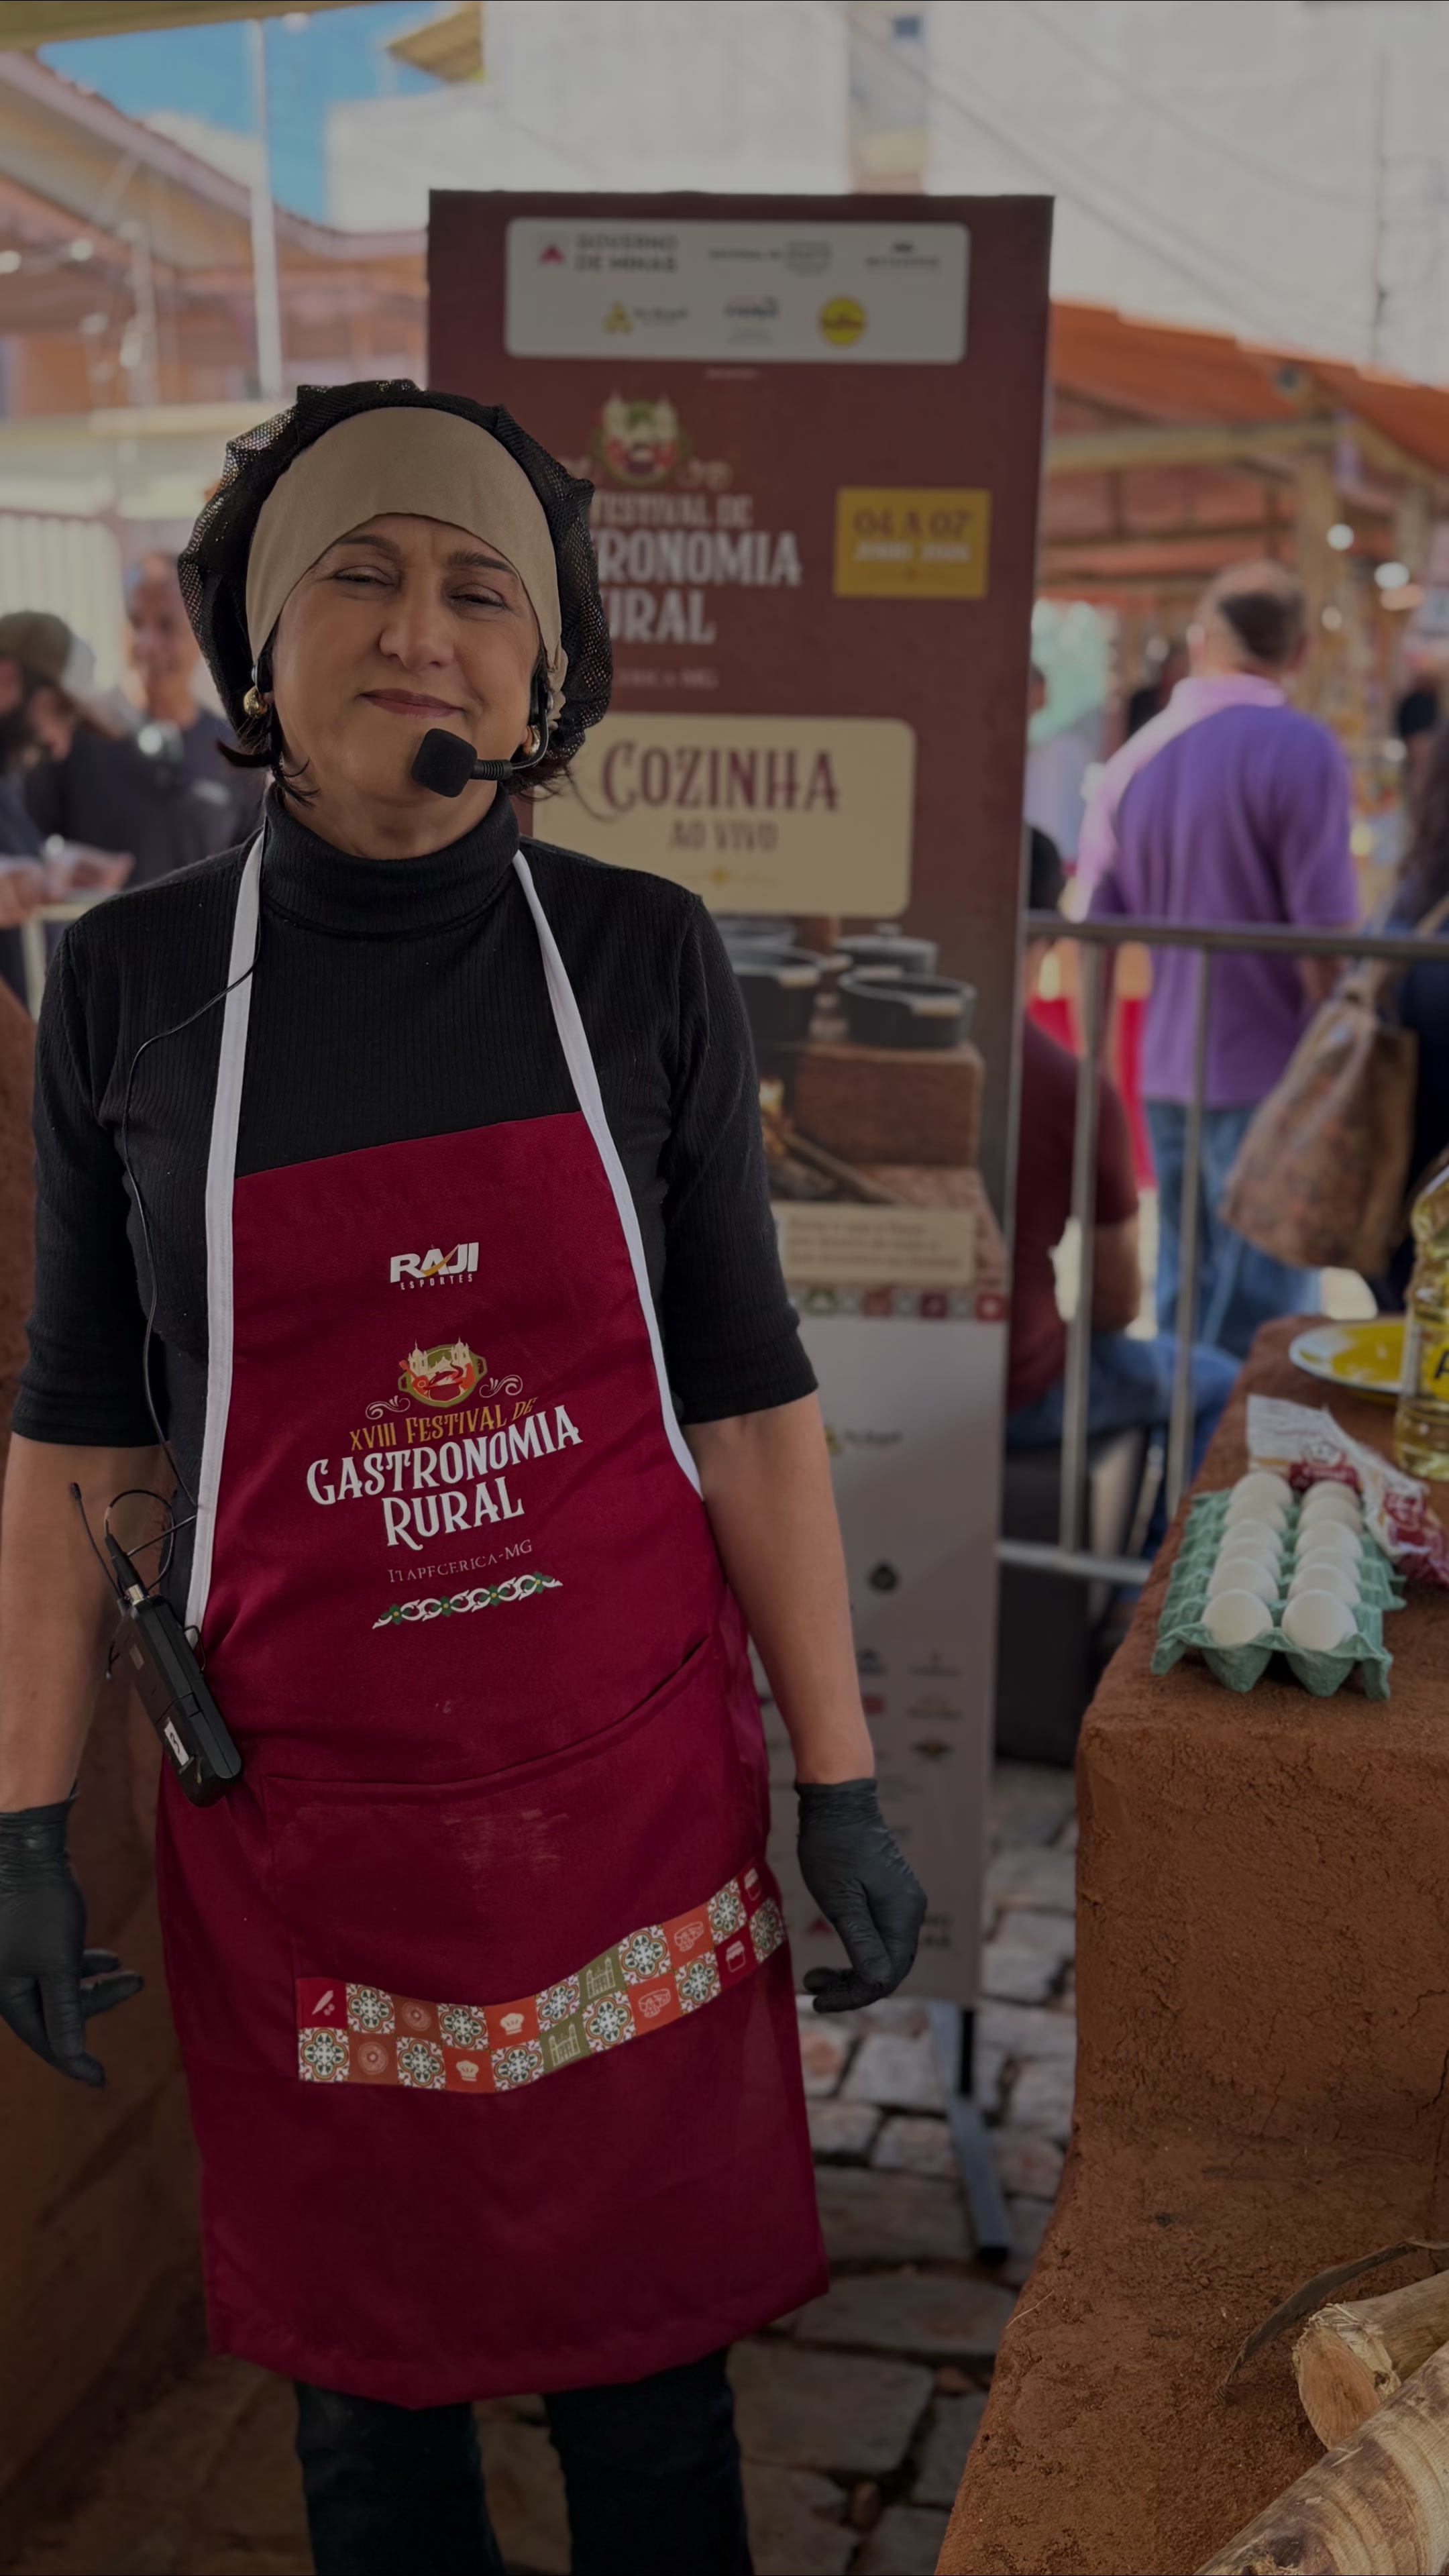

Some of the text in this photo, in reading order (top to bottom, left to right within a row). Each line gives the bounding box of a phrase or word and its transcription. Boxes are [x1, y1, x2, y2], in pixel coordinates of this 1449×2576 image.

[598, 739, 843, 814] COZINHA
[668, 818, 779, 853] AO VIVO
[390, 1242, 479, 1283] RAJI
[400, 1273, 473, 1291] ESPORTES
[349, 1397, 538, 1451] XVIII FESTIVAL DE
[306, 1404, 584, 1505] GASTRONOMIA
[382, 1475, 526, 1551] RURAL
